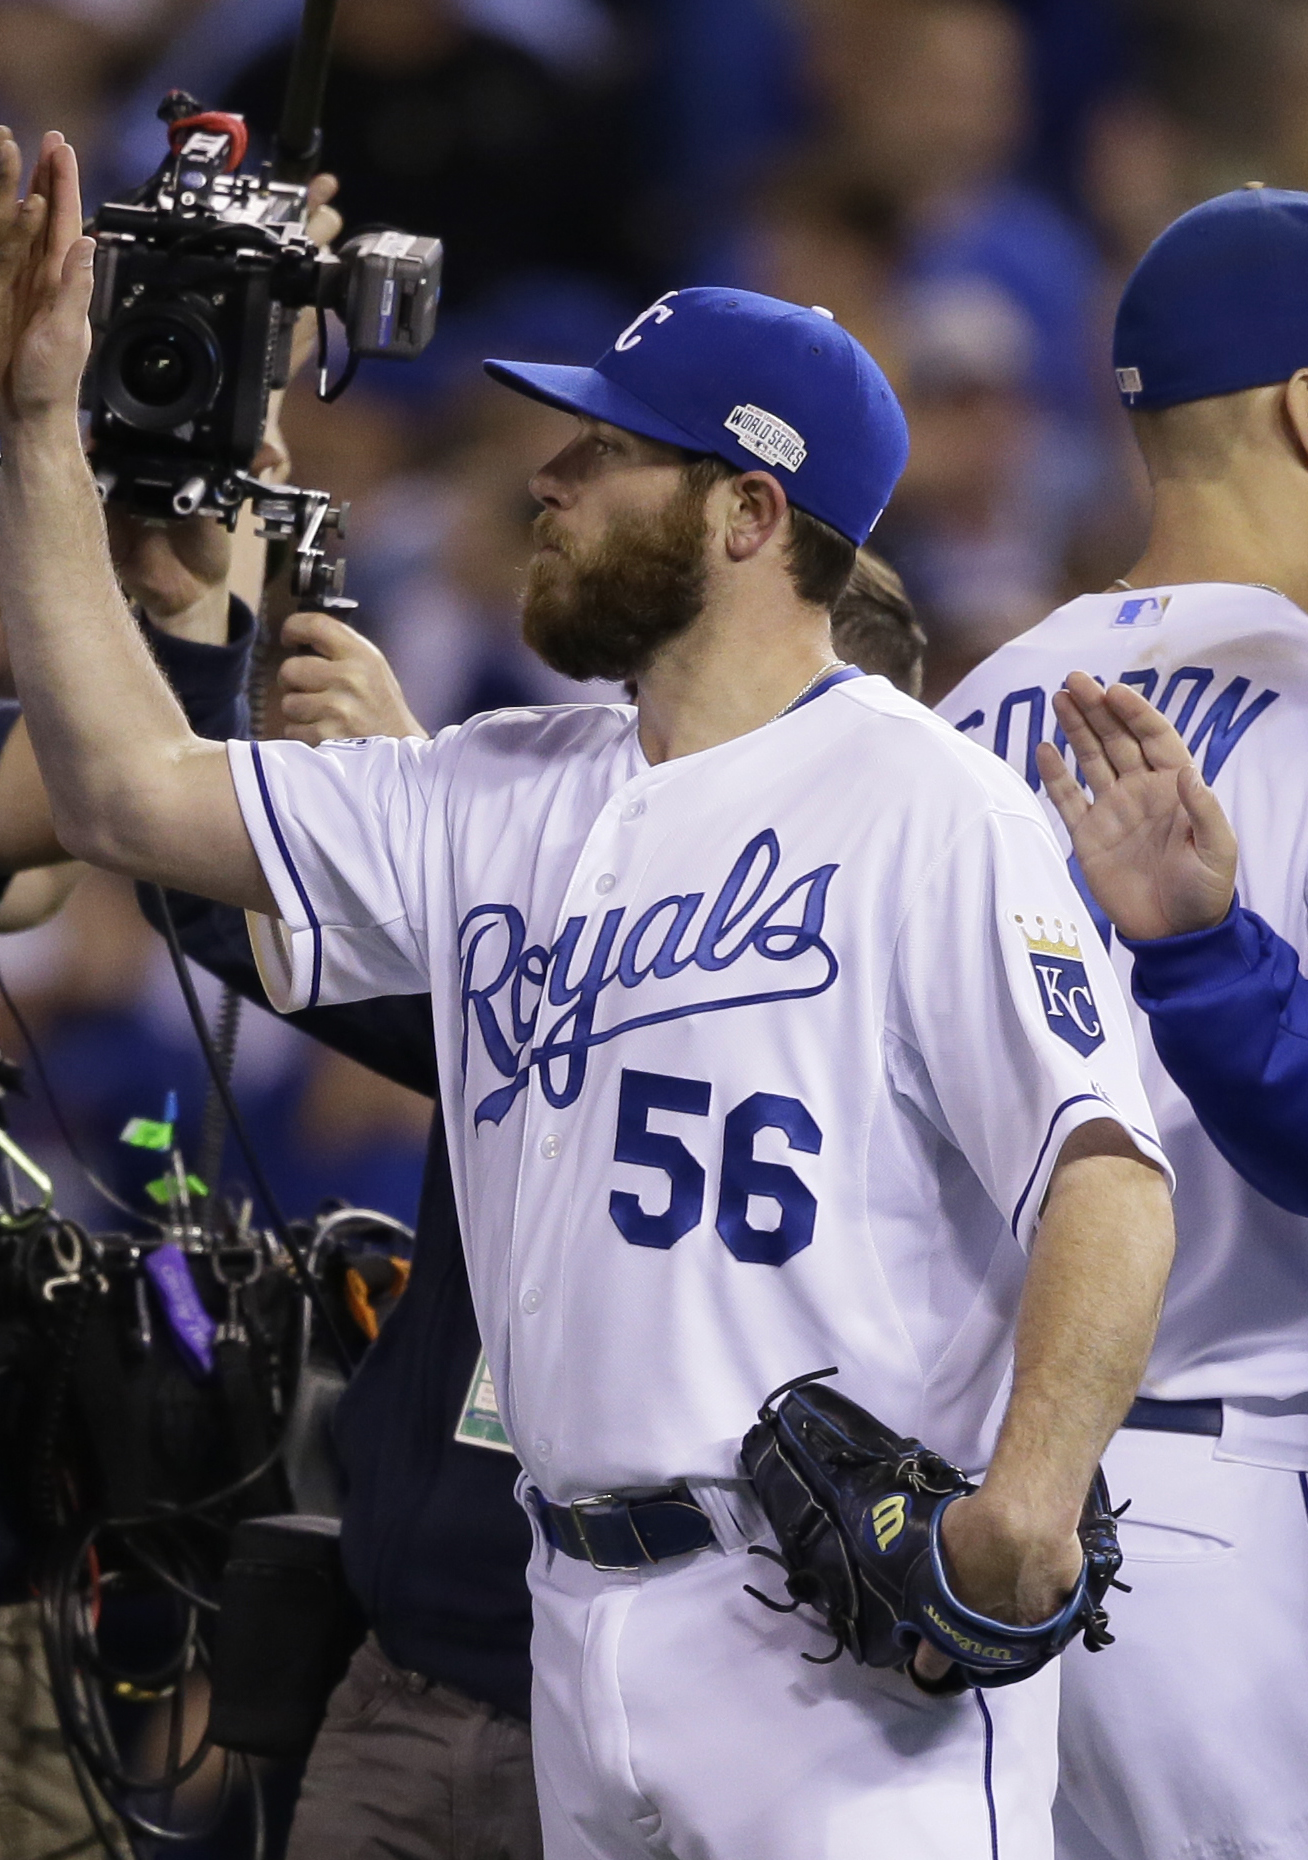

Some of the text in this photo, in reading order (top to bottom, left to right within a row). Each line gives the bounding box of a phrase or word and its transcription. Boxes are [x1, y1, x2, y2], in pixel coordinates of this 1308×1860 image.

[730, 409, 804, 467] WORLD SERIES
[458, 828, 840, 1137] Royals
[1035, 964, 1101, 1038] KC
[609, 1067, 823, 1267] 56
